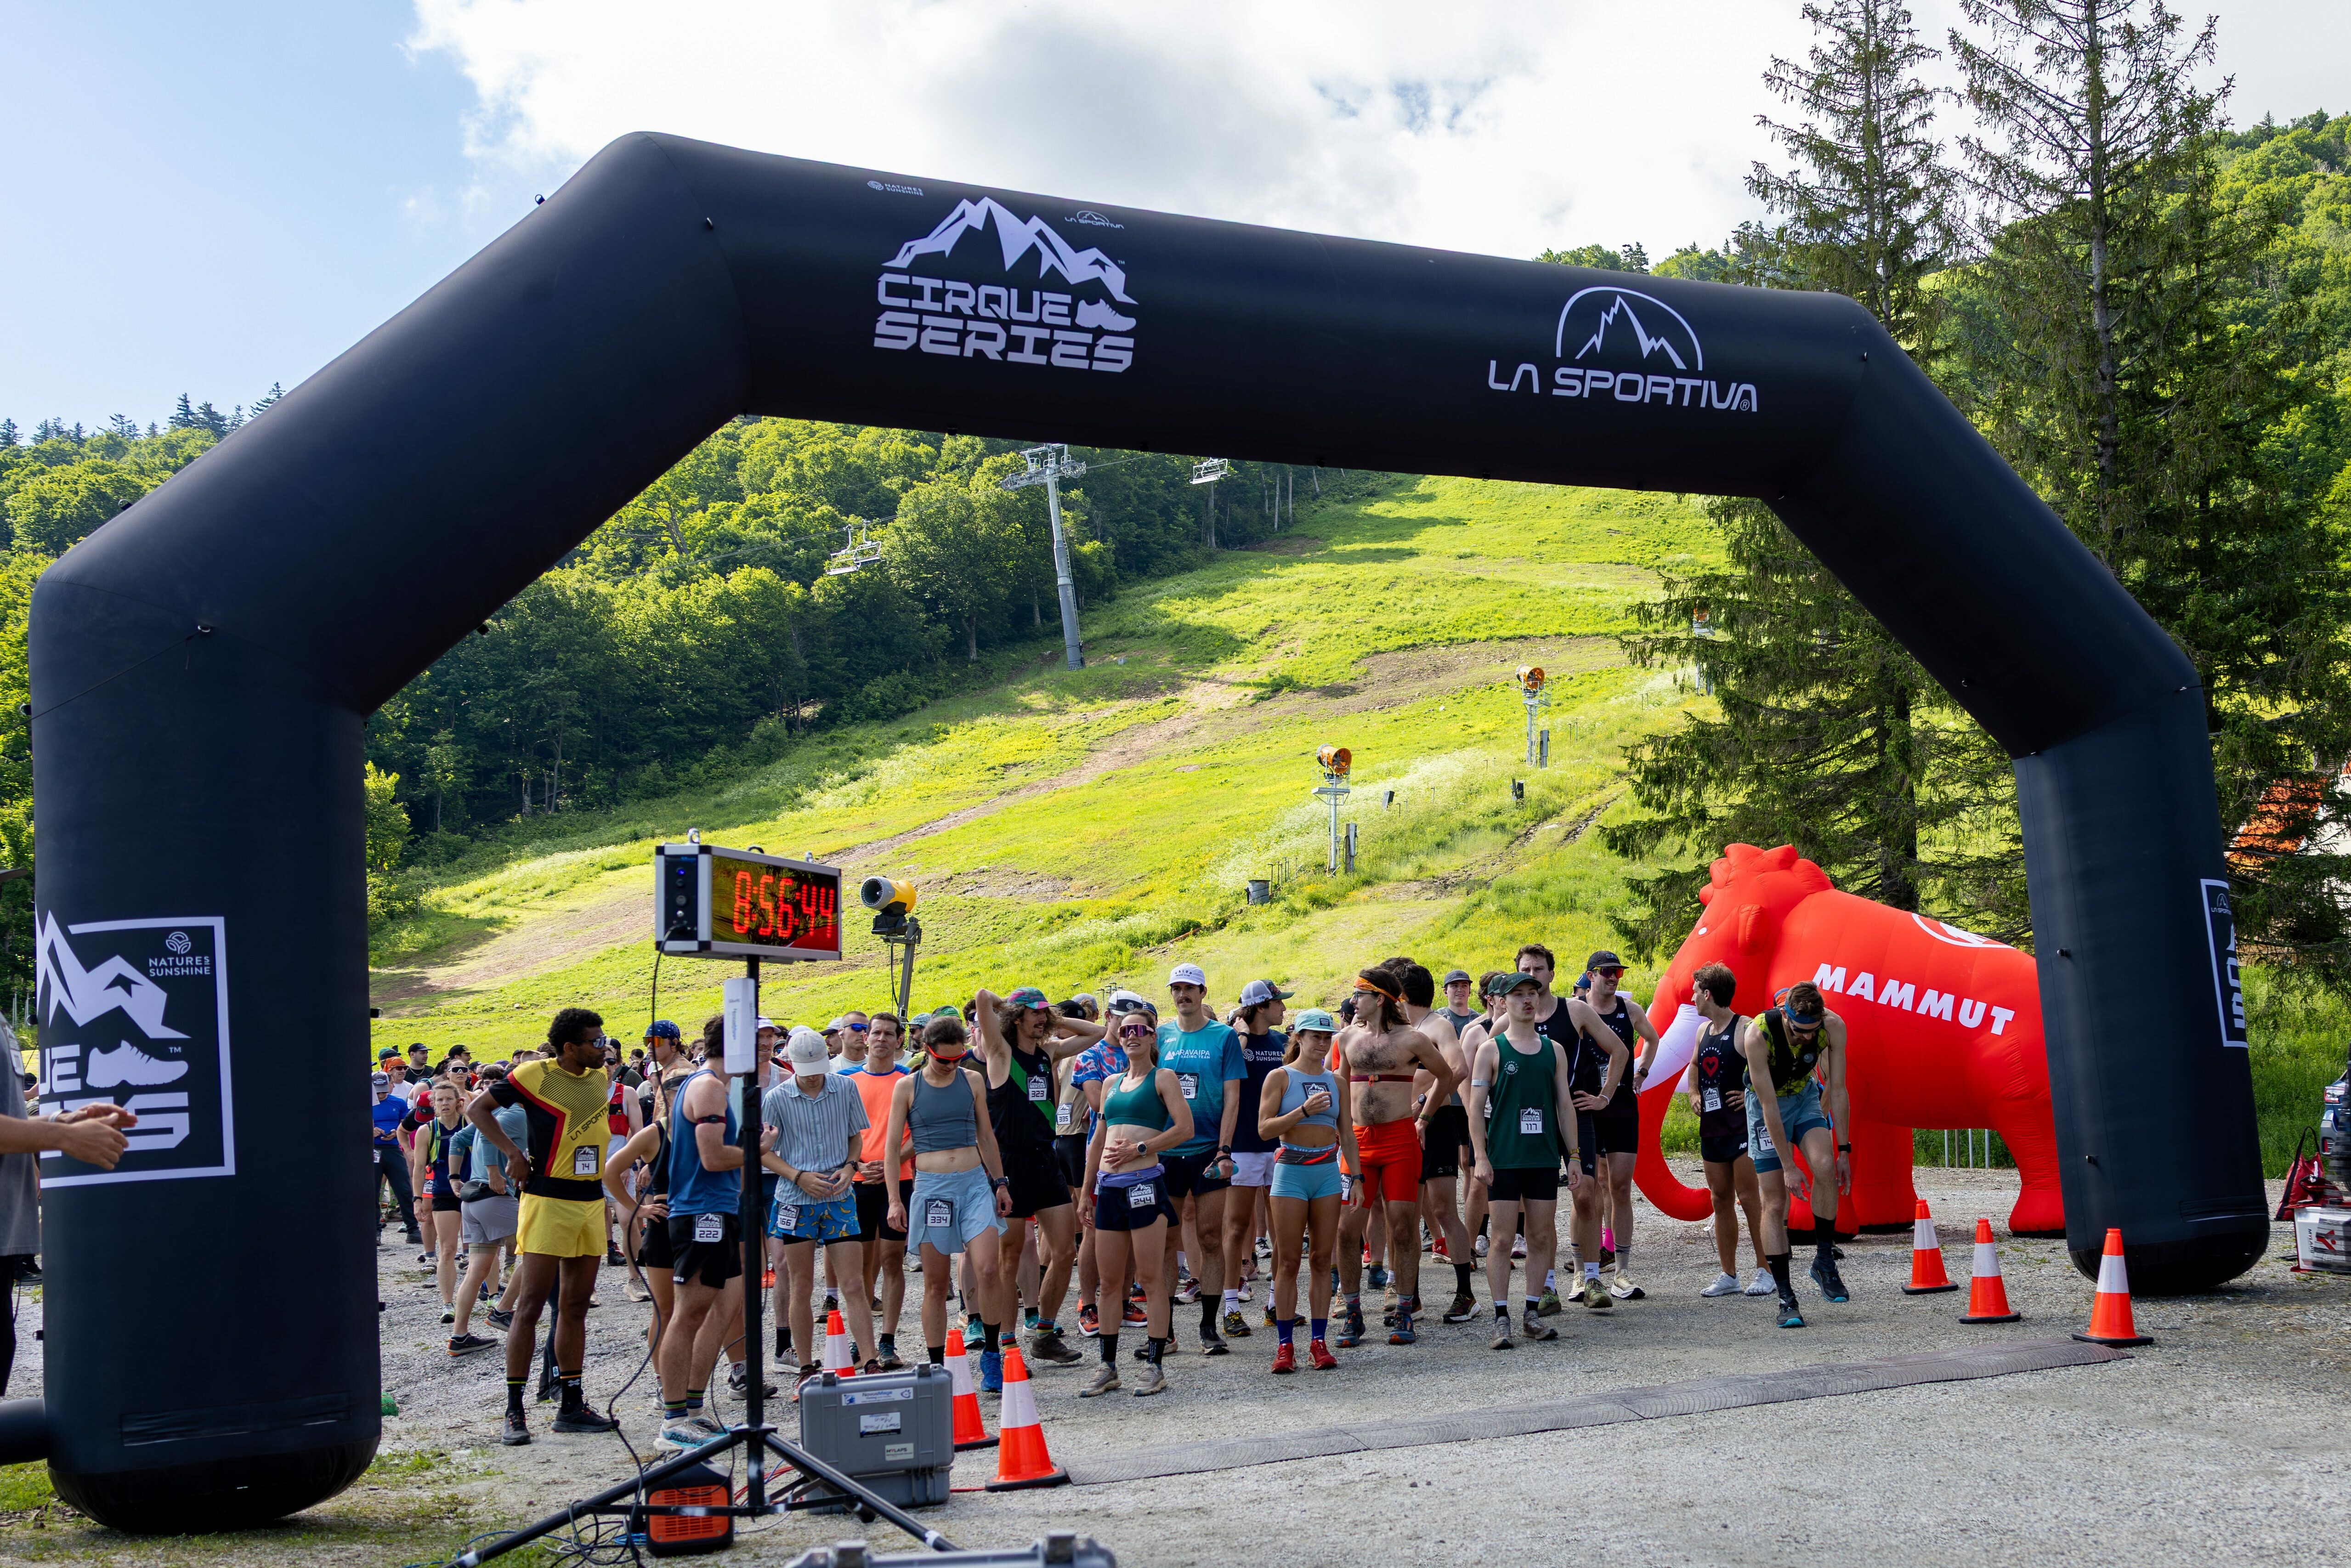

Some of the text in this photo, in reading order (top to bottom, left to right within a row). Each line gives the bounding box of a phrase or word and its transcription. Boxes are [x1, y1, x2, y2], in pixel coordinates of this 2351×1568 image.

[1078, 219, 1125, 229] SPORTIVA
[878, 272, 1072, 326] CIRQUE
[874, 311, 1135, 373] SERIES
[1488, 360, 1539, 394] LA
[149, 956, 210, 967] NATURES
[149, 967, 210, 977] SUNSHINE
[1812, 962, 2015, 1036] MAMMUT
[1708, 1100, 1718, 1108] 193
[570, 1130, 582, 1141] LA
[1133, 1196, 1152, 1205] 244
[780, 1217, 792, 1226] 166
